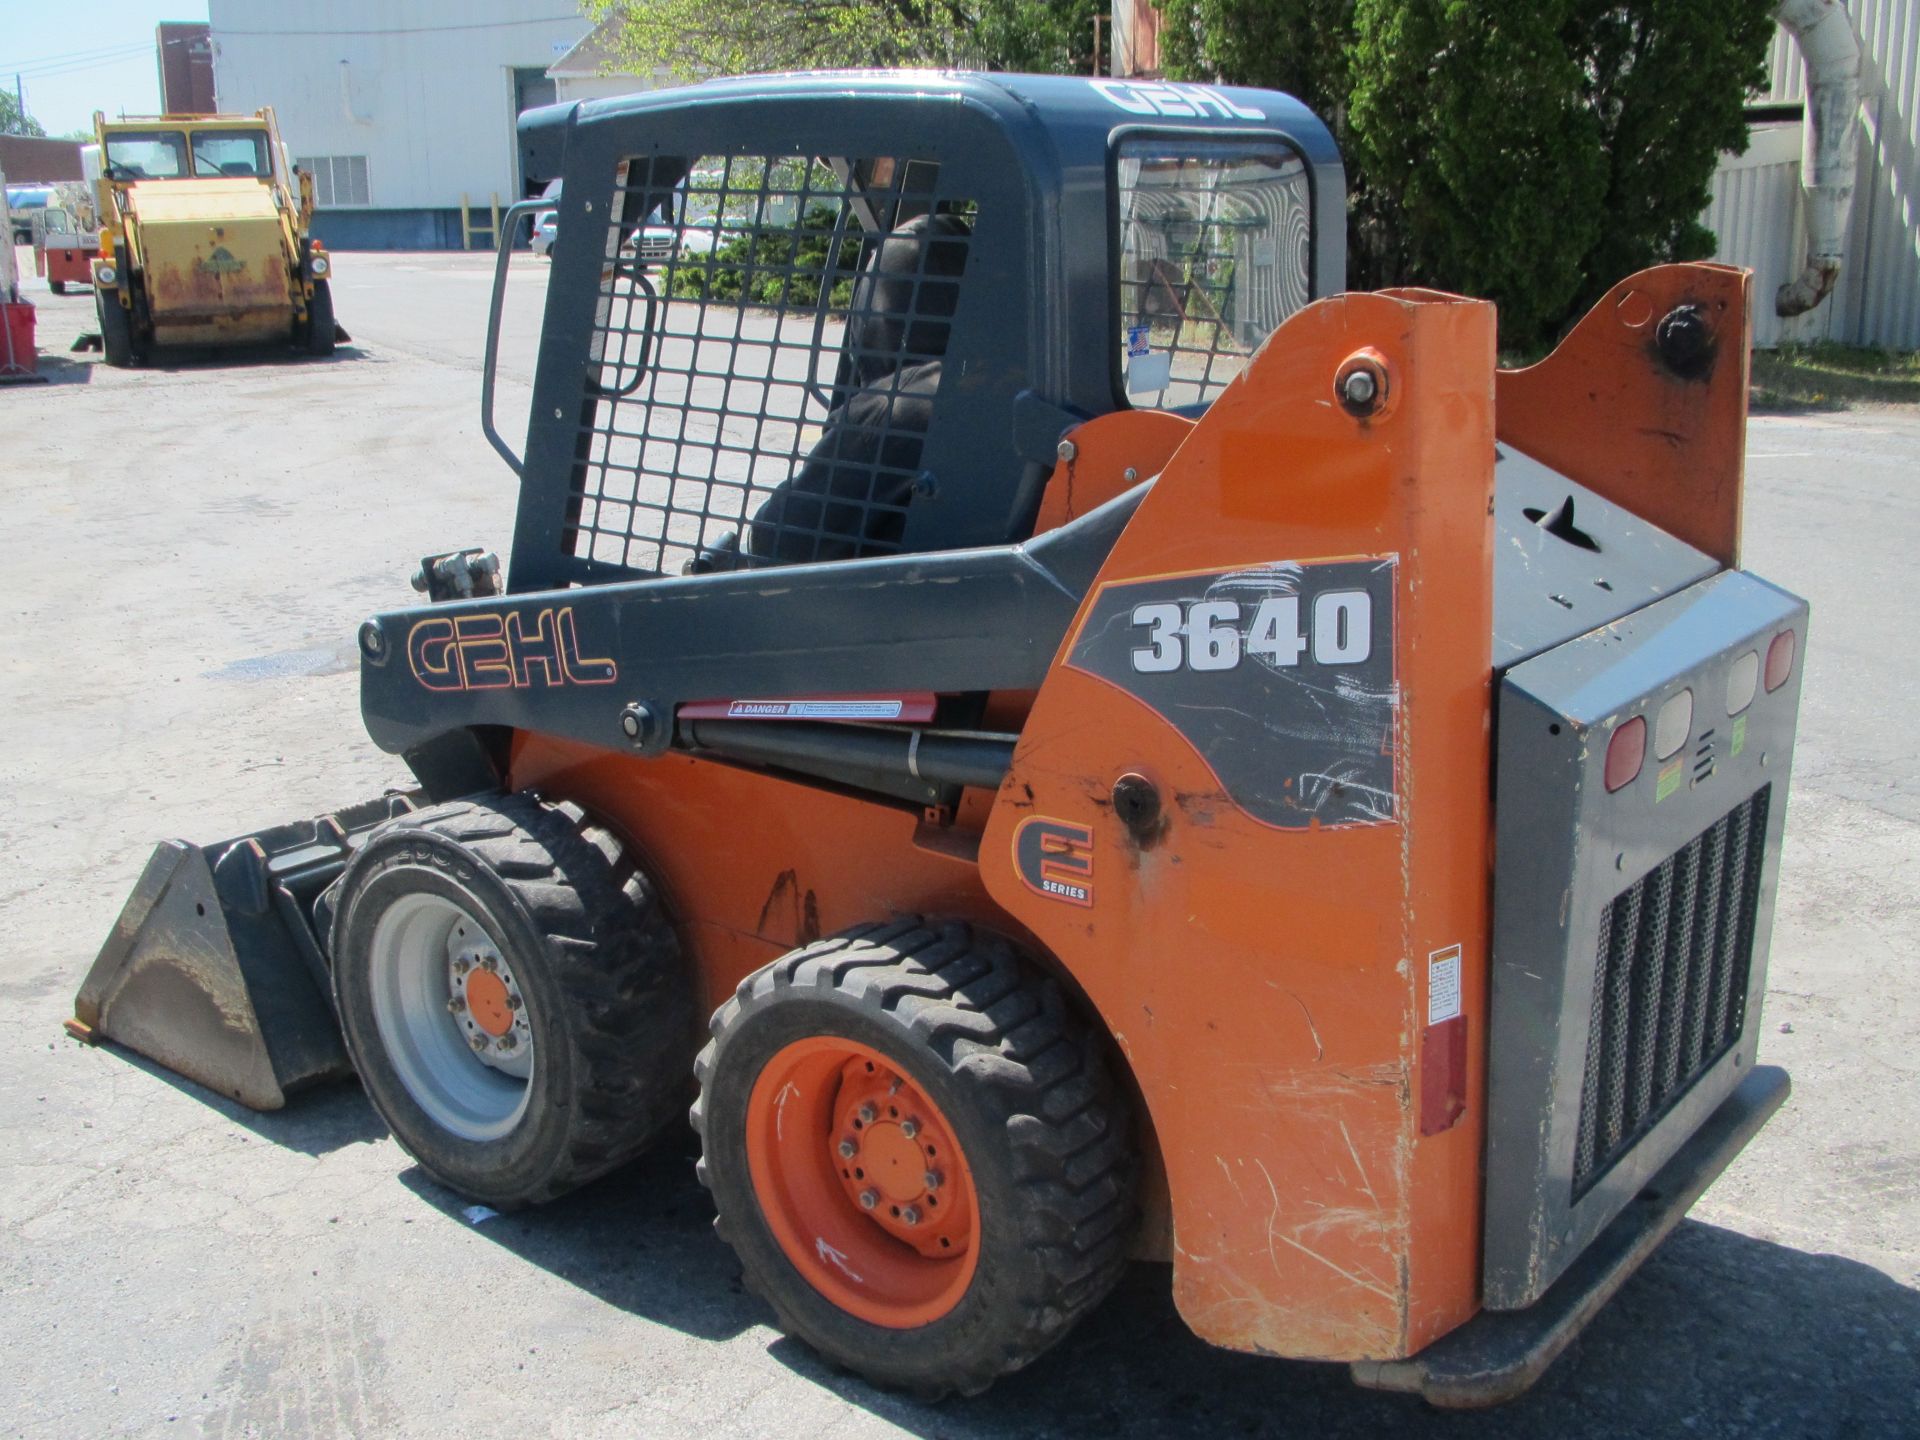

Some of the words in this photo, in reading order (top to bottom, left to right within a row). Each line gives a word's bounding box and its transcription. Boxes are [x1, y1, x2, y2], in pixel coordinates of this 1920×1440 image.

[1087, 80, 1266, 121] GEHL
[408, 607, 617, 691] GEHL
[1132, 591, 1371, 672] 3640
[745, 704, 786, 715] DANGER
[1042, 880, 1086, 899] SERIES
